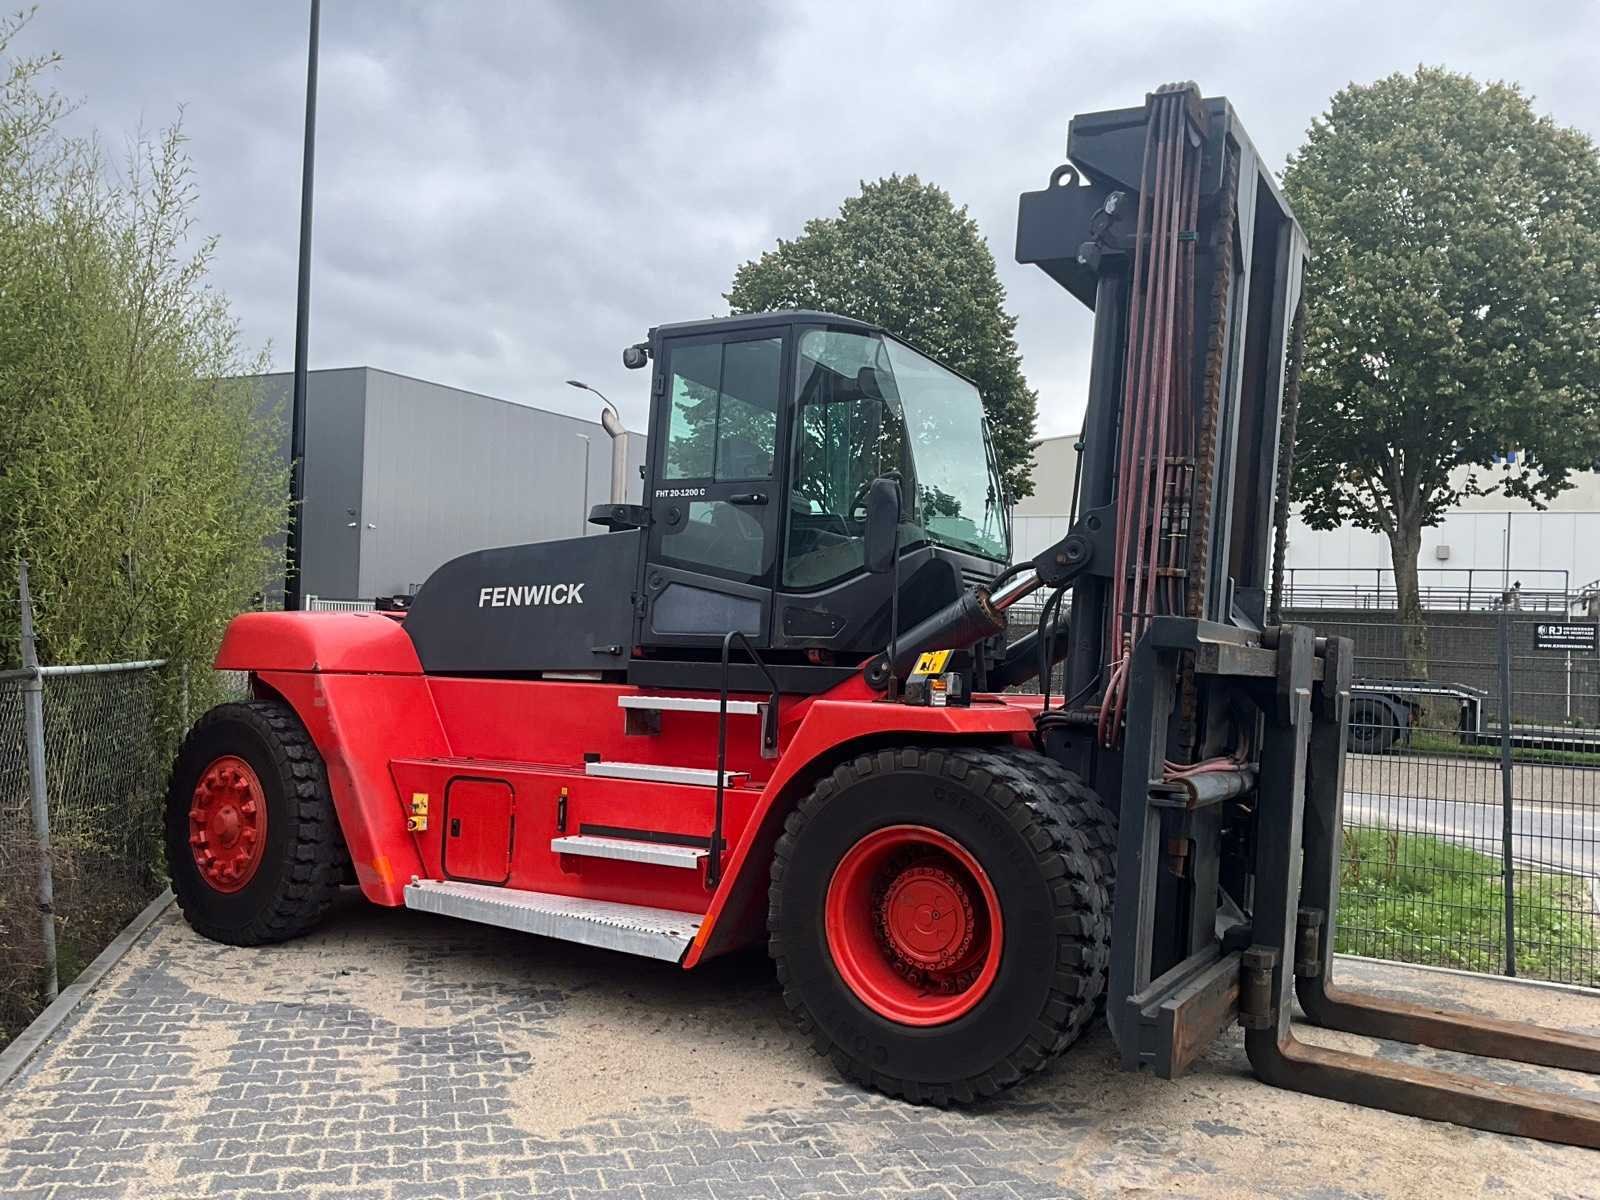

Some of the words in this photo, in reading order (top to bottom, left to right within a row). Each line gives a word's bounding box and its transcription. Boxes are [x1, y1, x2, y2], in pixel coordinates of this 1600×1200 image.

[655, 489, 669, 498] FHT
[669, 488, 699, 497] 20-1200
[699, 488, 706, 496] C
[478, 582, 585, 608] FENWICK
[1548, 626, 1563, 635] RJ
